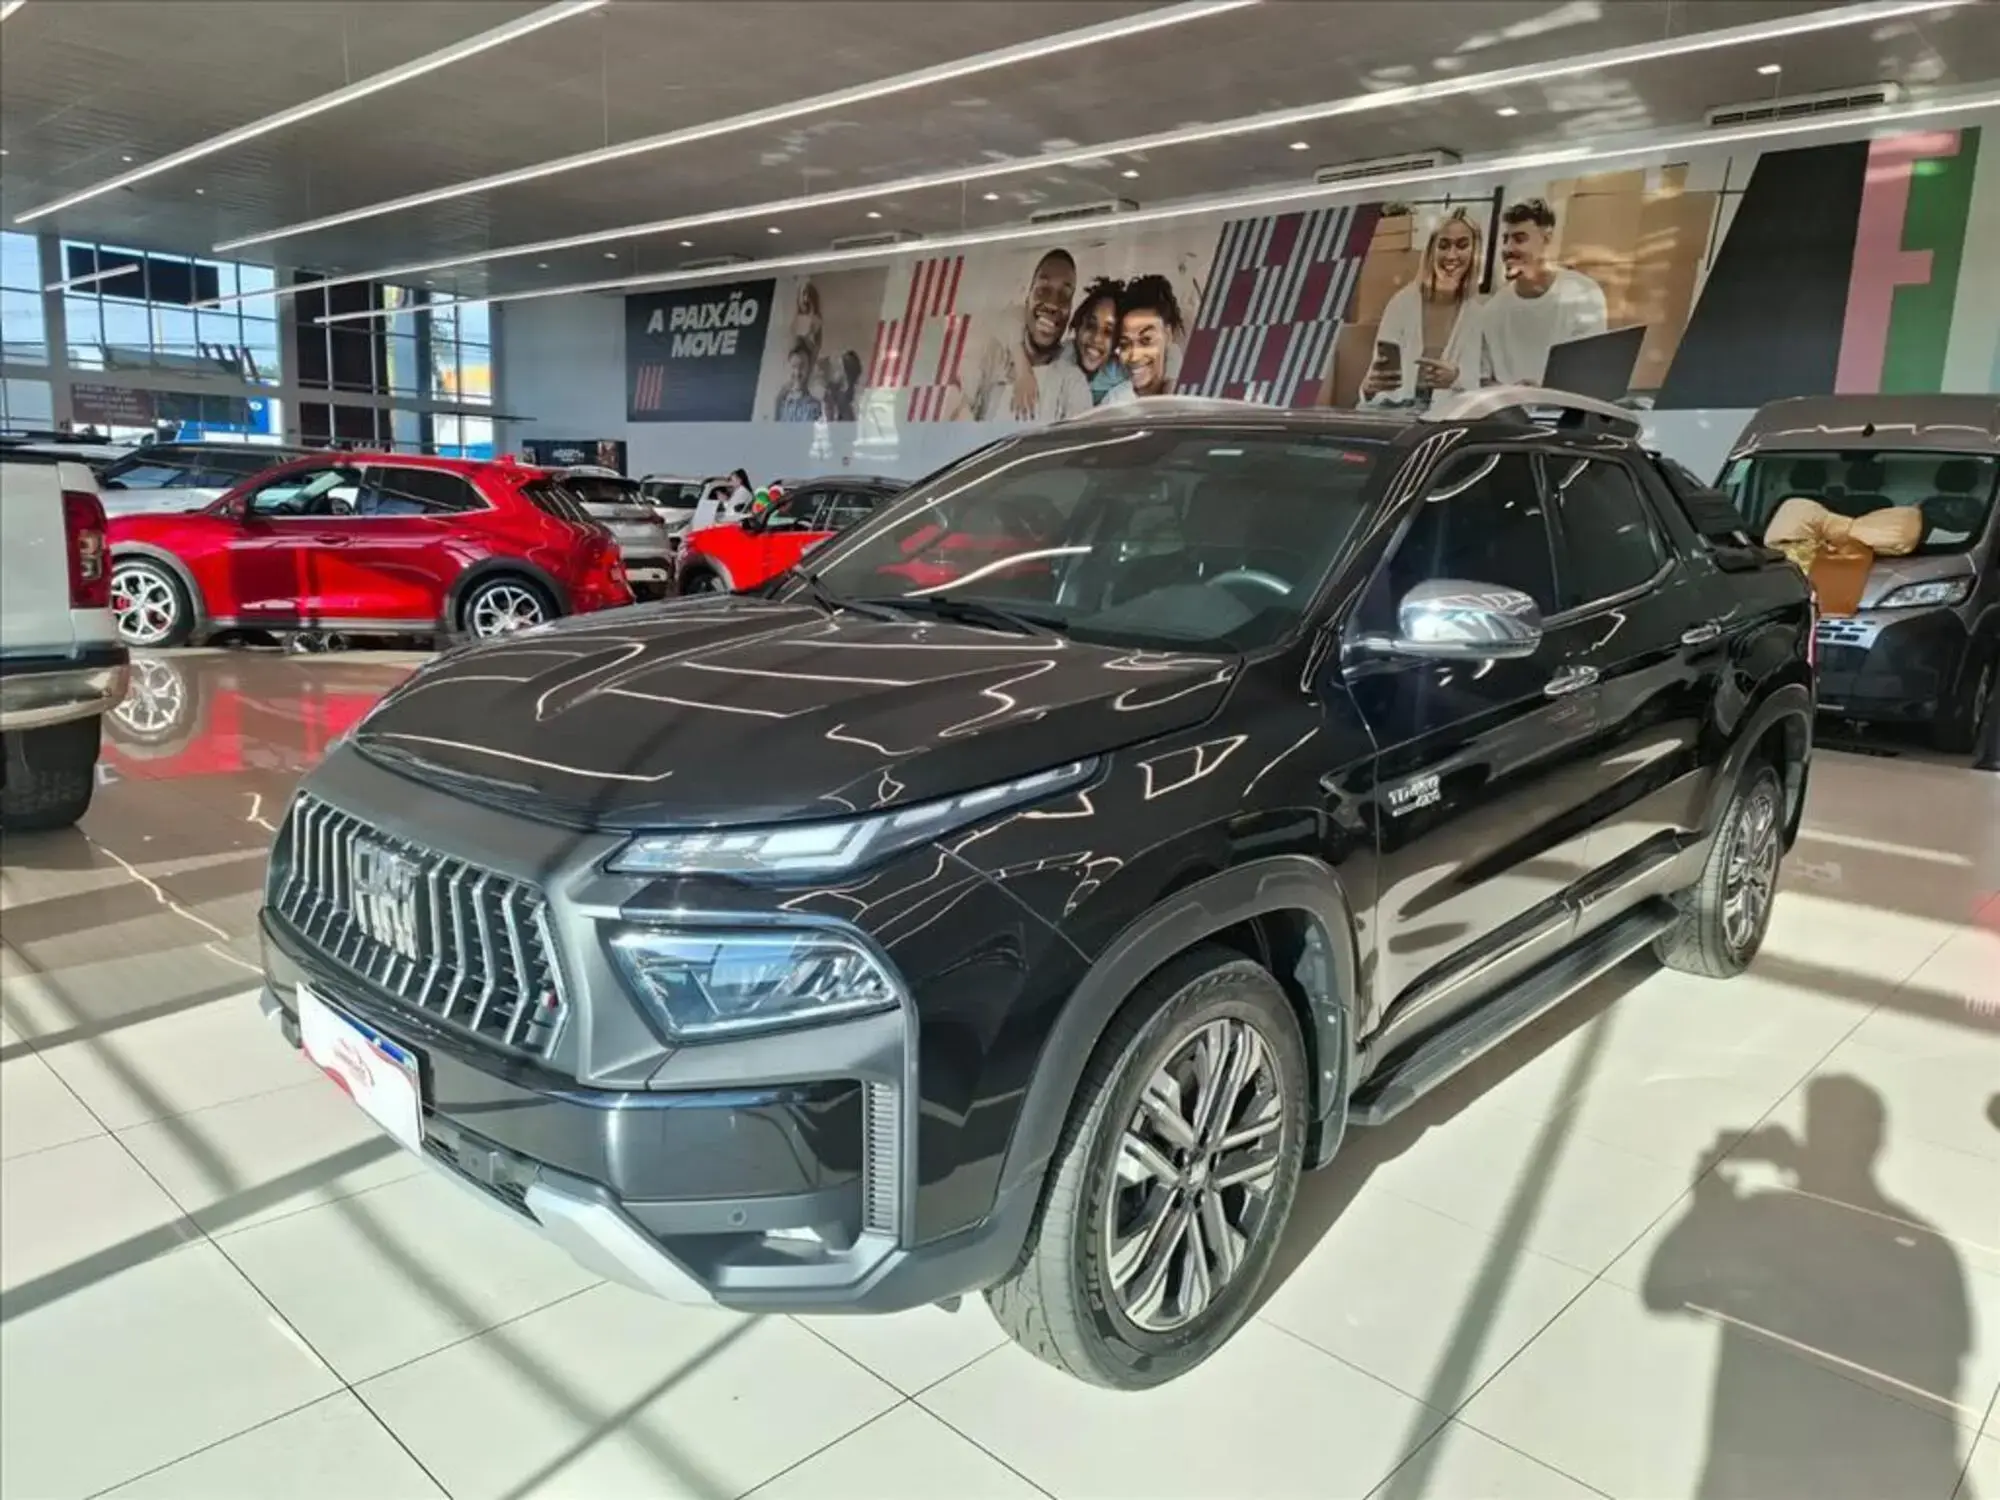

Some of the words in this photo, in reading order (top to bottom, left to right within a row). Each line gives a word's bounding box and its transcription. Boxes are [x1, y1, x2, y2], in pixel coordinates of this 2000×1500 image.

[646, 309, 663, 334] A
[669, 291, 758, 332] PAIXÃO
[671, 329, 739, 358] MOVE
